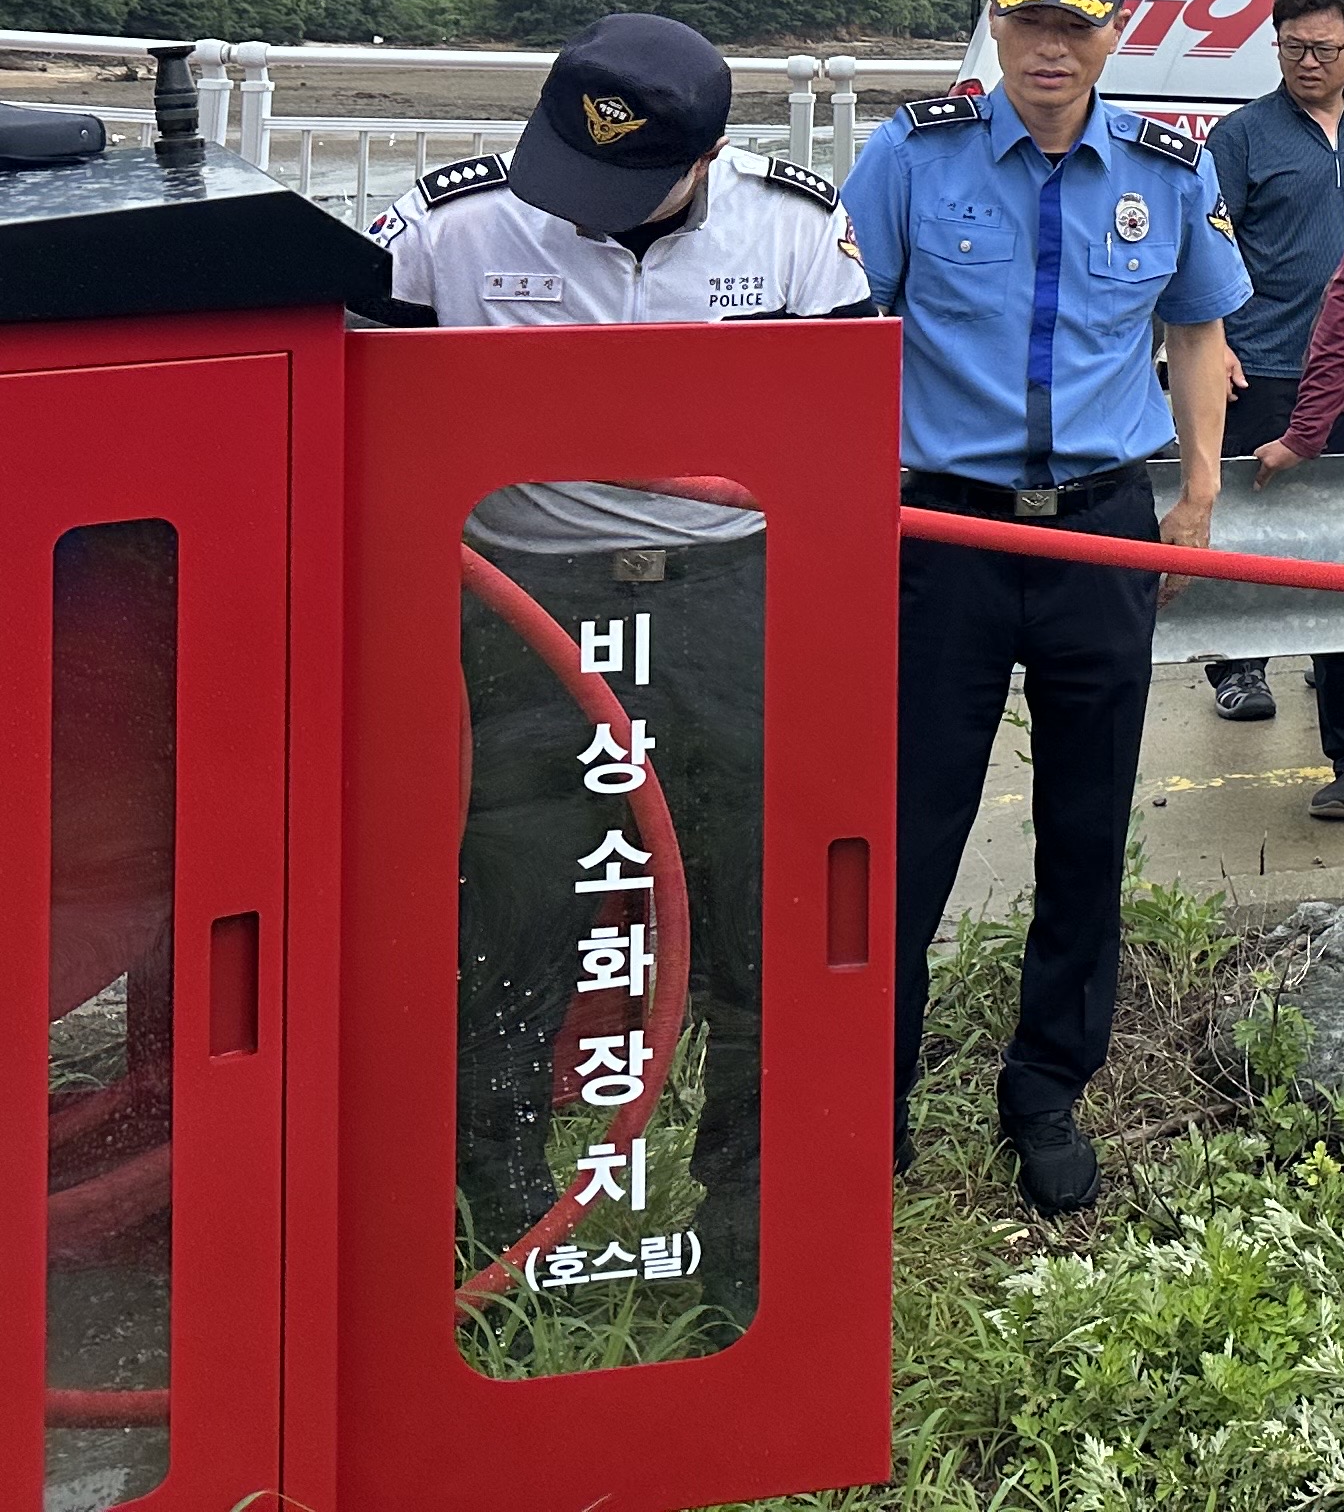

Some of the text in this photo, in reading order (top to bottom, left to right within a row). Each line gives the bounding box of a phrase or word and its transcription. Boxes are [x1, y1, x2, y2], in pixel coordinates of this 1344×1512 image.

[708, 275, 765, 291] 해양경찰
[708, 292, 764, 308] POLICE
[573, 612, 656, 1211] 비상소화장치
[524, 1230, 702, 1292] (호스릴)
